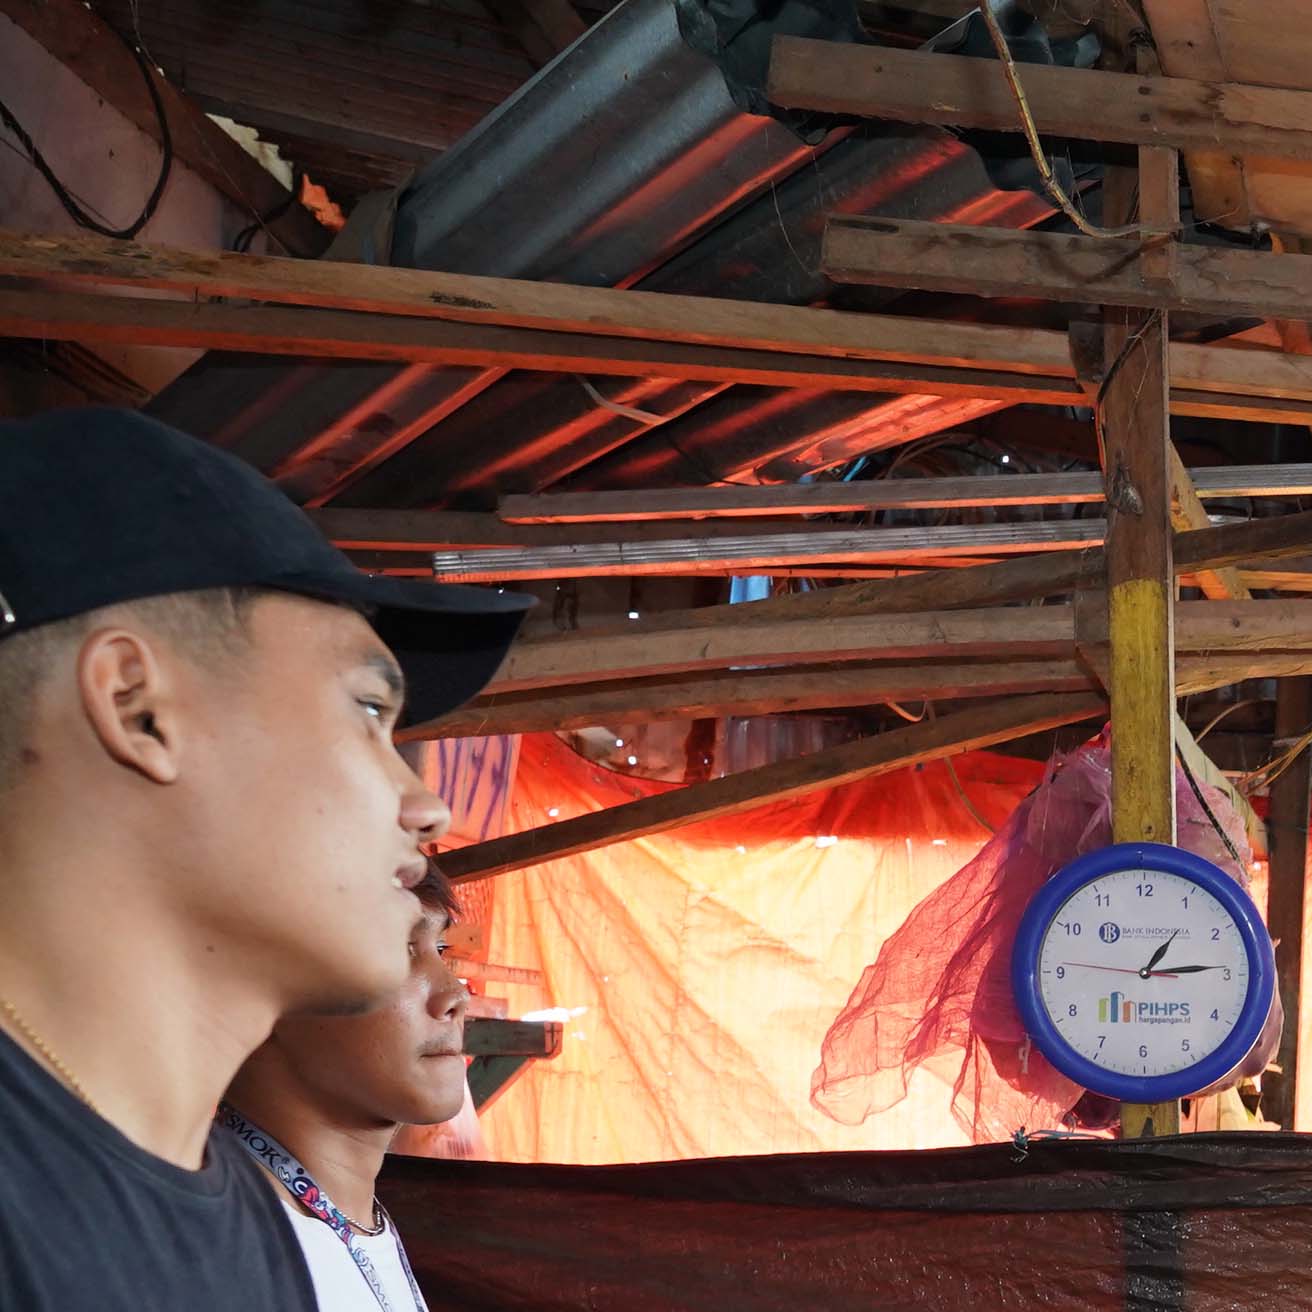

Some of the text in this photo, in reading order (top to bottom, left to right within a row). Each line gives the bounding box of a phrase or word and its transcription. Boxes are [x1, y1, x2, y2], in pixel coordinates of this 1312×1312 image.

[1136, 884, 1153, 897] 12
[1096, 894, 1111, 907] 11
[1181, 898, 1189, 909] 1
[1064, 922, 1081, 936] 10
[1122, 927, 1144, 935] BANK
[1211, 927, 1220, 941] 2
[1056, 966, 1065, 980] 9
[1223, 968, 1232, 981] 3
[1068, 1004, 1077, 1017] 8
[1138, 1002, 1190, 1015] PIHPS
[1210, 1008, 1219, 1021] 4
[1097, 1036, 1107, 1049] 7
[1181, 1039, 1190, 1052] 5
[1138, 1045, 1148, 1058] 6
[225, 1113, 280, 1169] SMOK
